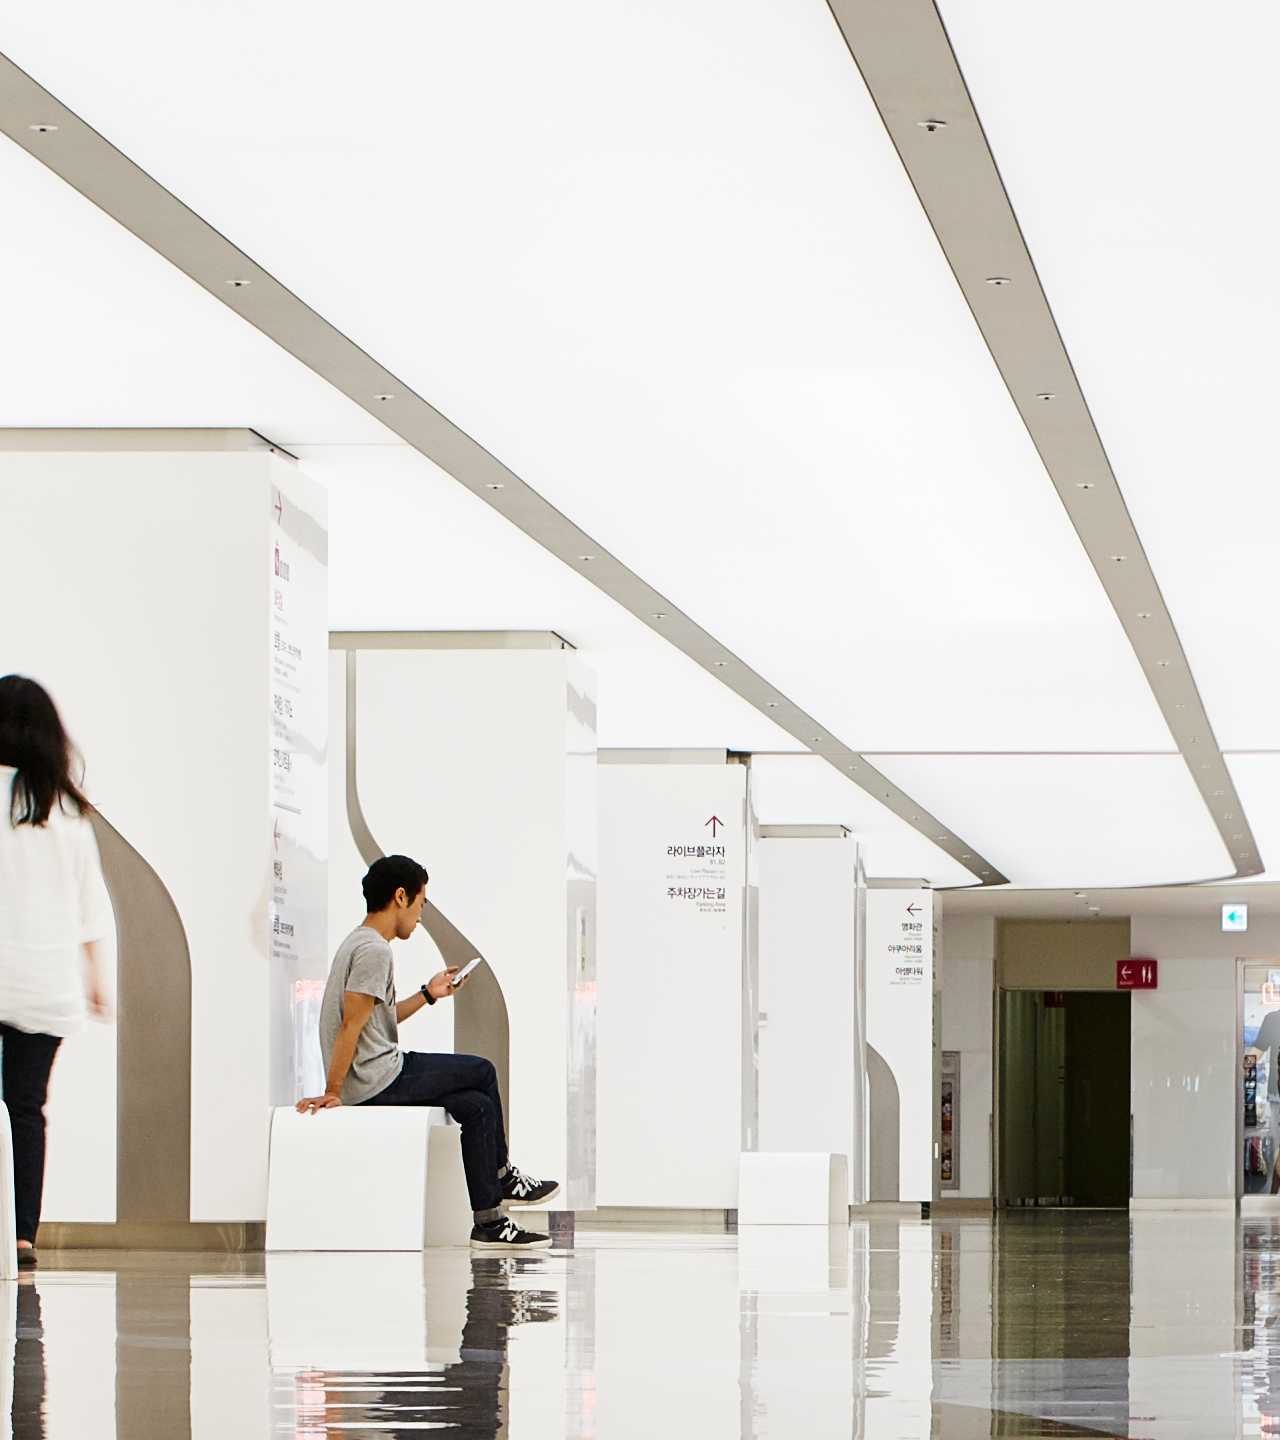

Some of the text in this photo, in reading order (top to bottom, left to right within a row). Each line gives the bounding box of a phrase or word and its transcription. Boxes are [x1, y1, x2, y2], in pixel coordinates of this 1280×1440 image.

[667, 846, 725, 858] 라이브플라자
[667, 887, 726, 900] 주차장가는길
[499, 1226, 519, 1241] N
